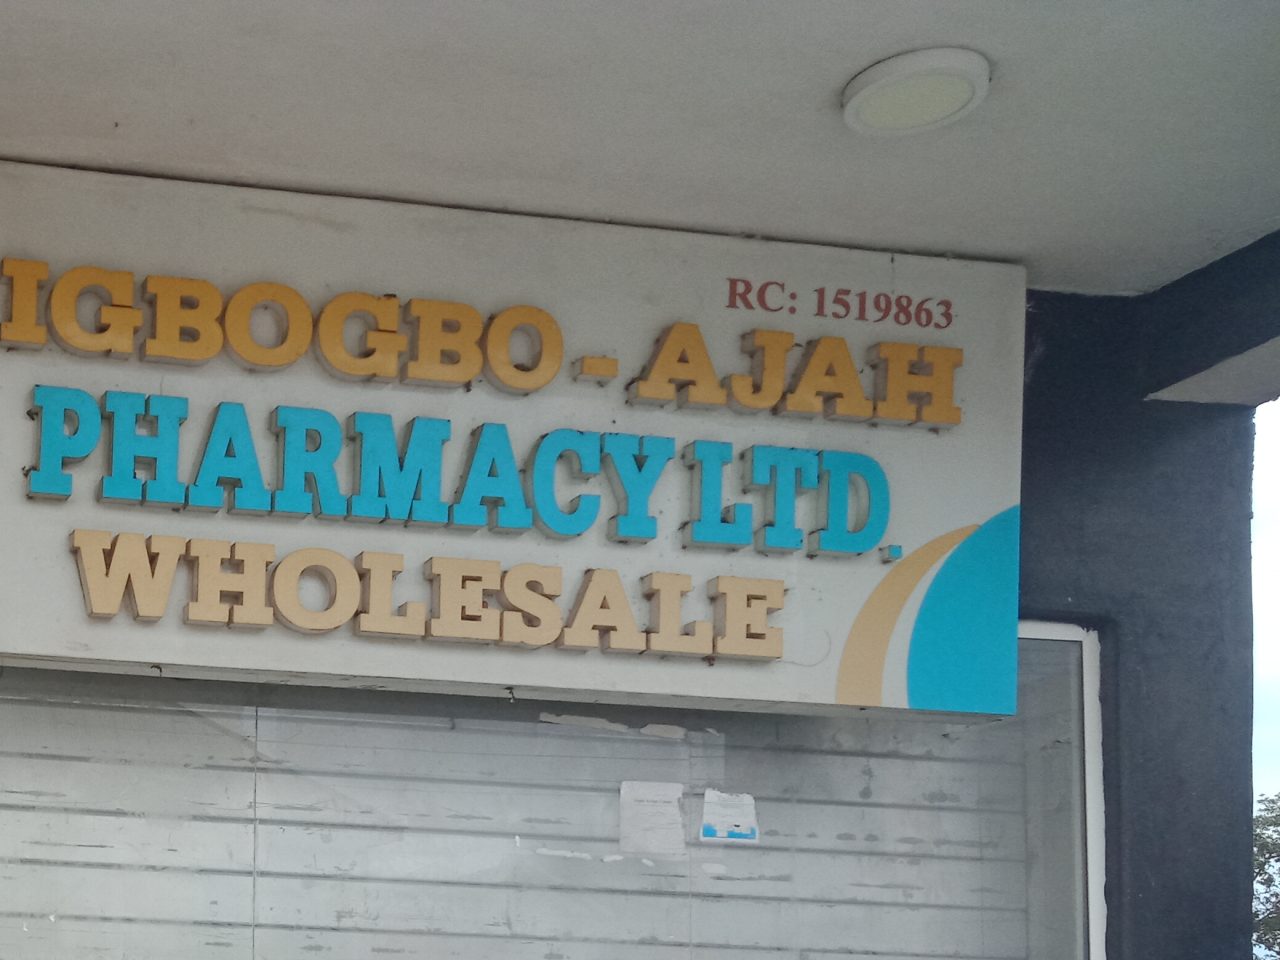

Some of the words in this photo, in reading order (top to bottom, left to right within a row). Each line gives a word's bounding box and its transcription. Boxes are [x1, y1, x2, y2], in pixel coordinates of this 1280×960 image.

[725, 277, 799, 319] RC:
[810, 286, 955, 331] 1519863
[628, 322, 963, 427] AJAH
[24, 384, 673, 544] PHARMACY
[70, 529, 790, 666] WHOLESALE
